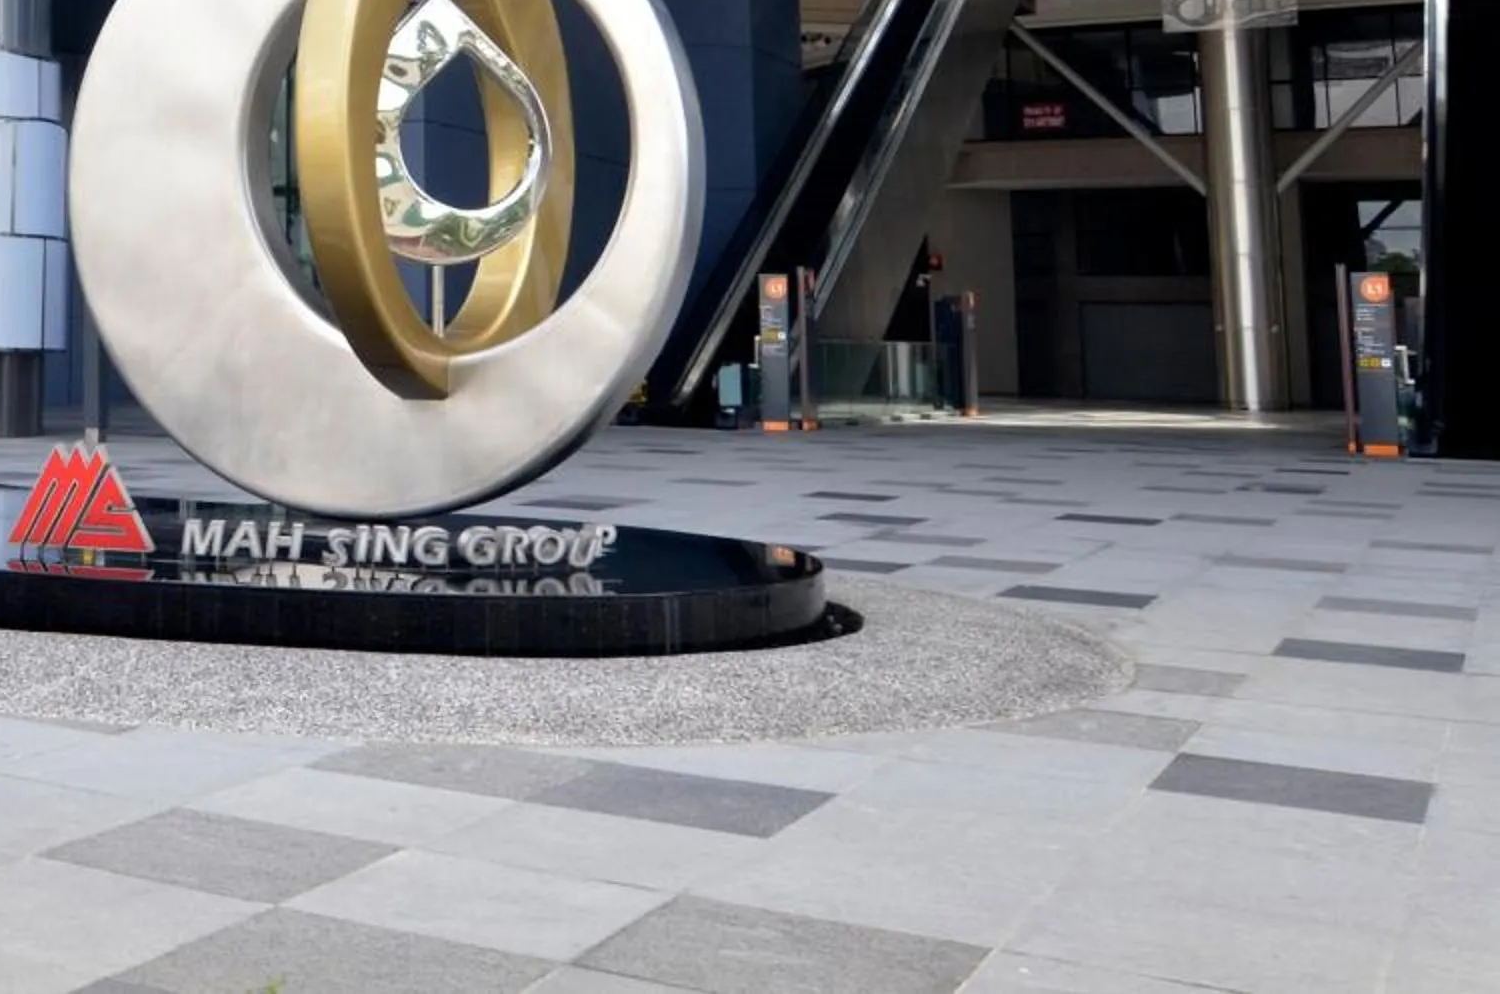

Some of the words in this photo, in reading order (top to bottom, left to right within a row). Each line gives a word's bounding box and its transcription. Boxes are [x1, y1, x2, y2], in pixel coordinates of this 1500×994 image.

[180, 518, 305, 559] MAH
[321, 524, 449, 568] SING
[457, 523, 618, 568] GROUP
